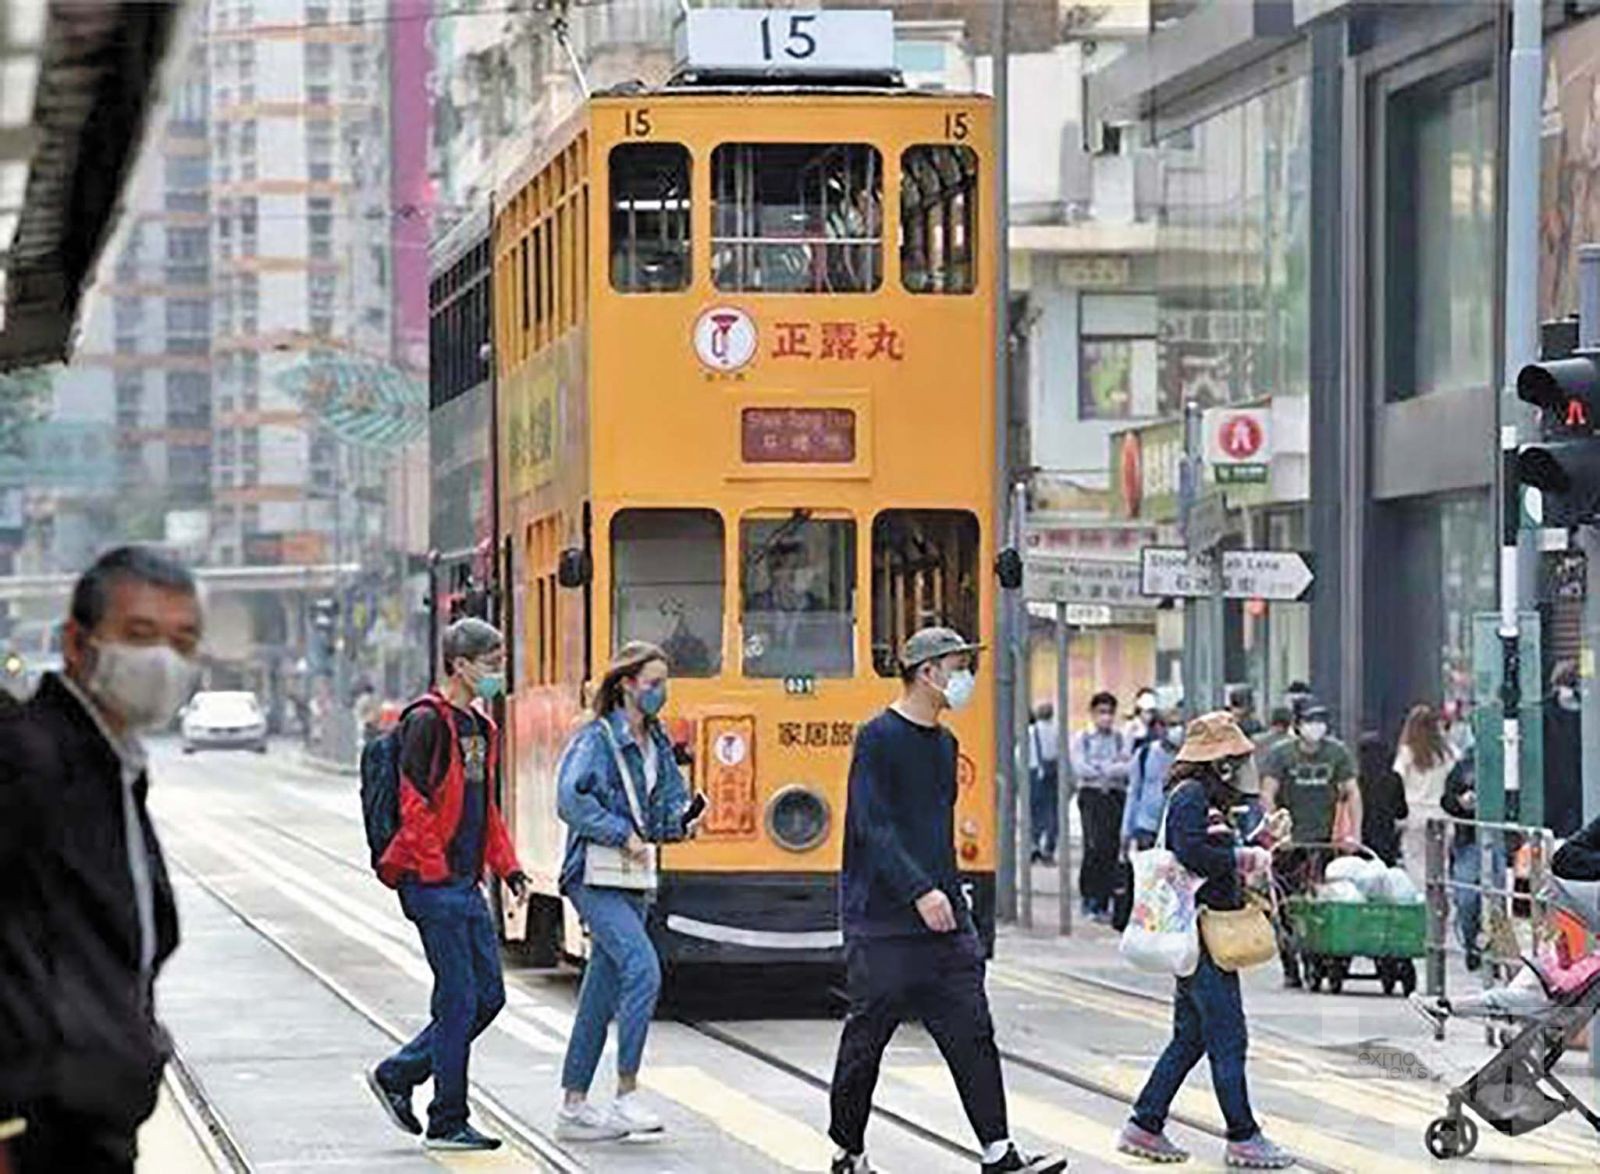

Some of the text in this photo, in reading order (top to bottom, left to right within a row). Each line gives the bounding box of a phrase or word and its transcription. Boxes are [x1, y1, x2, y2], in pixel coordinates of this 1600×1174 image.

[759, 15, 817, 61] 15
[624, 110, 651, 136] 15
[944, 113, 969, 140] 15
[771, 321, 905, 361] 正露丸
